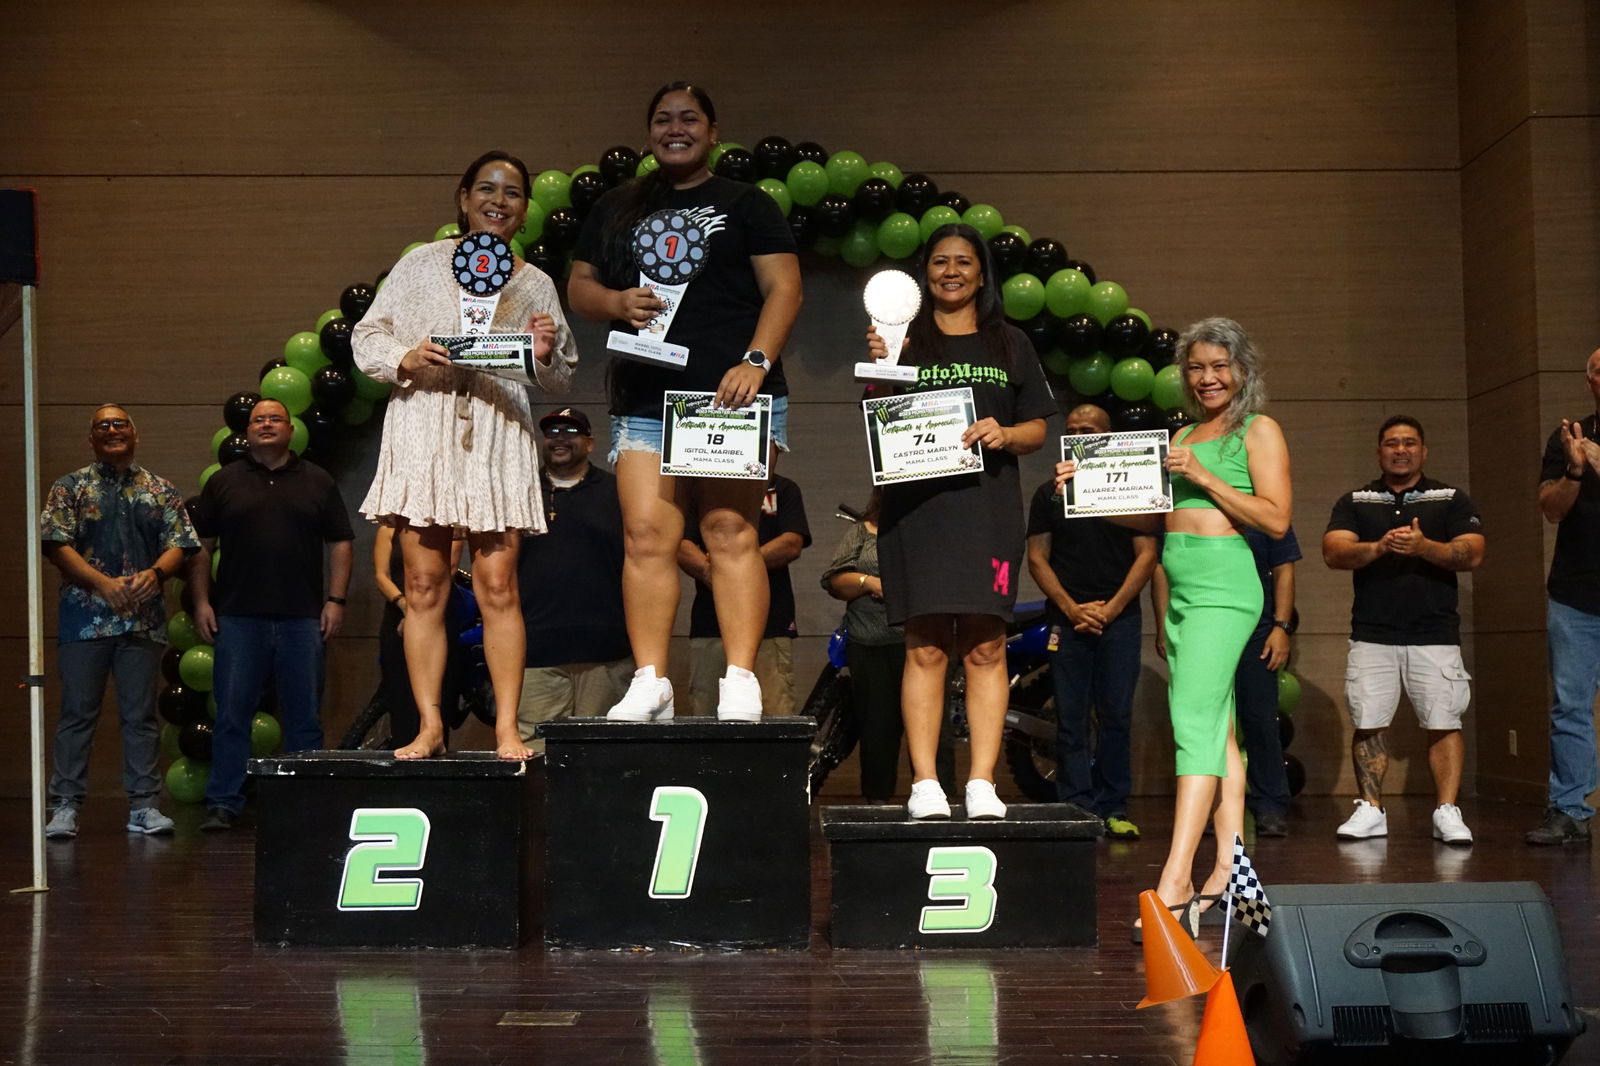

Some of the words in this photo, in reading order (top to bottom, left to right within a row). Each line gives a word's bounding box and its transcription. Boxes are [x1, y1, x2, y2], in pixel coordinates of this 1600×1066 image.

[665, 236, 679, 259] 1
[475, 254, 490, 273] 2
[707, 433, 725, 445] 18
[913, 433, 936, 446] 74
[927, 445, 958, 454] MARLYN
[1106, 471, 1128, 484] 171
[1119, 484, 1154, 492] MARIANA
[991, 557, 1010, 596] 74
[648, 786, 708, 899] 1
[337, 808, 430, 911] 2
[919, 846, 997, 934] 3
